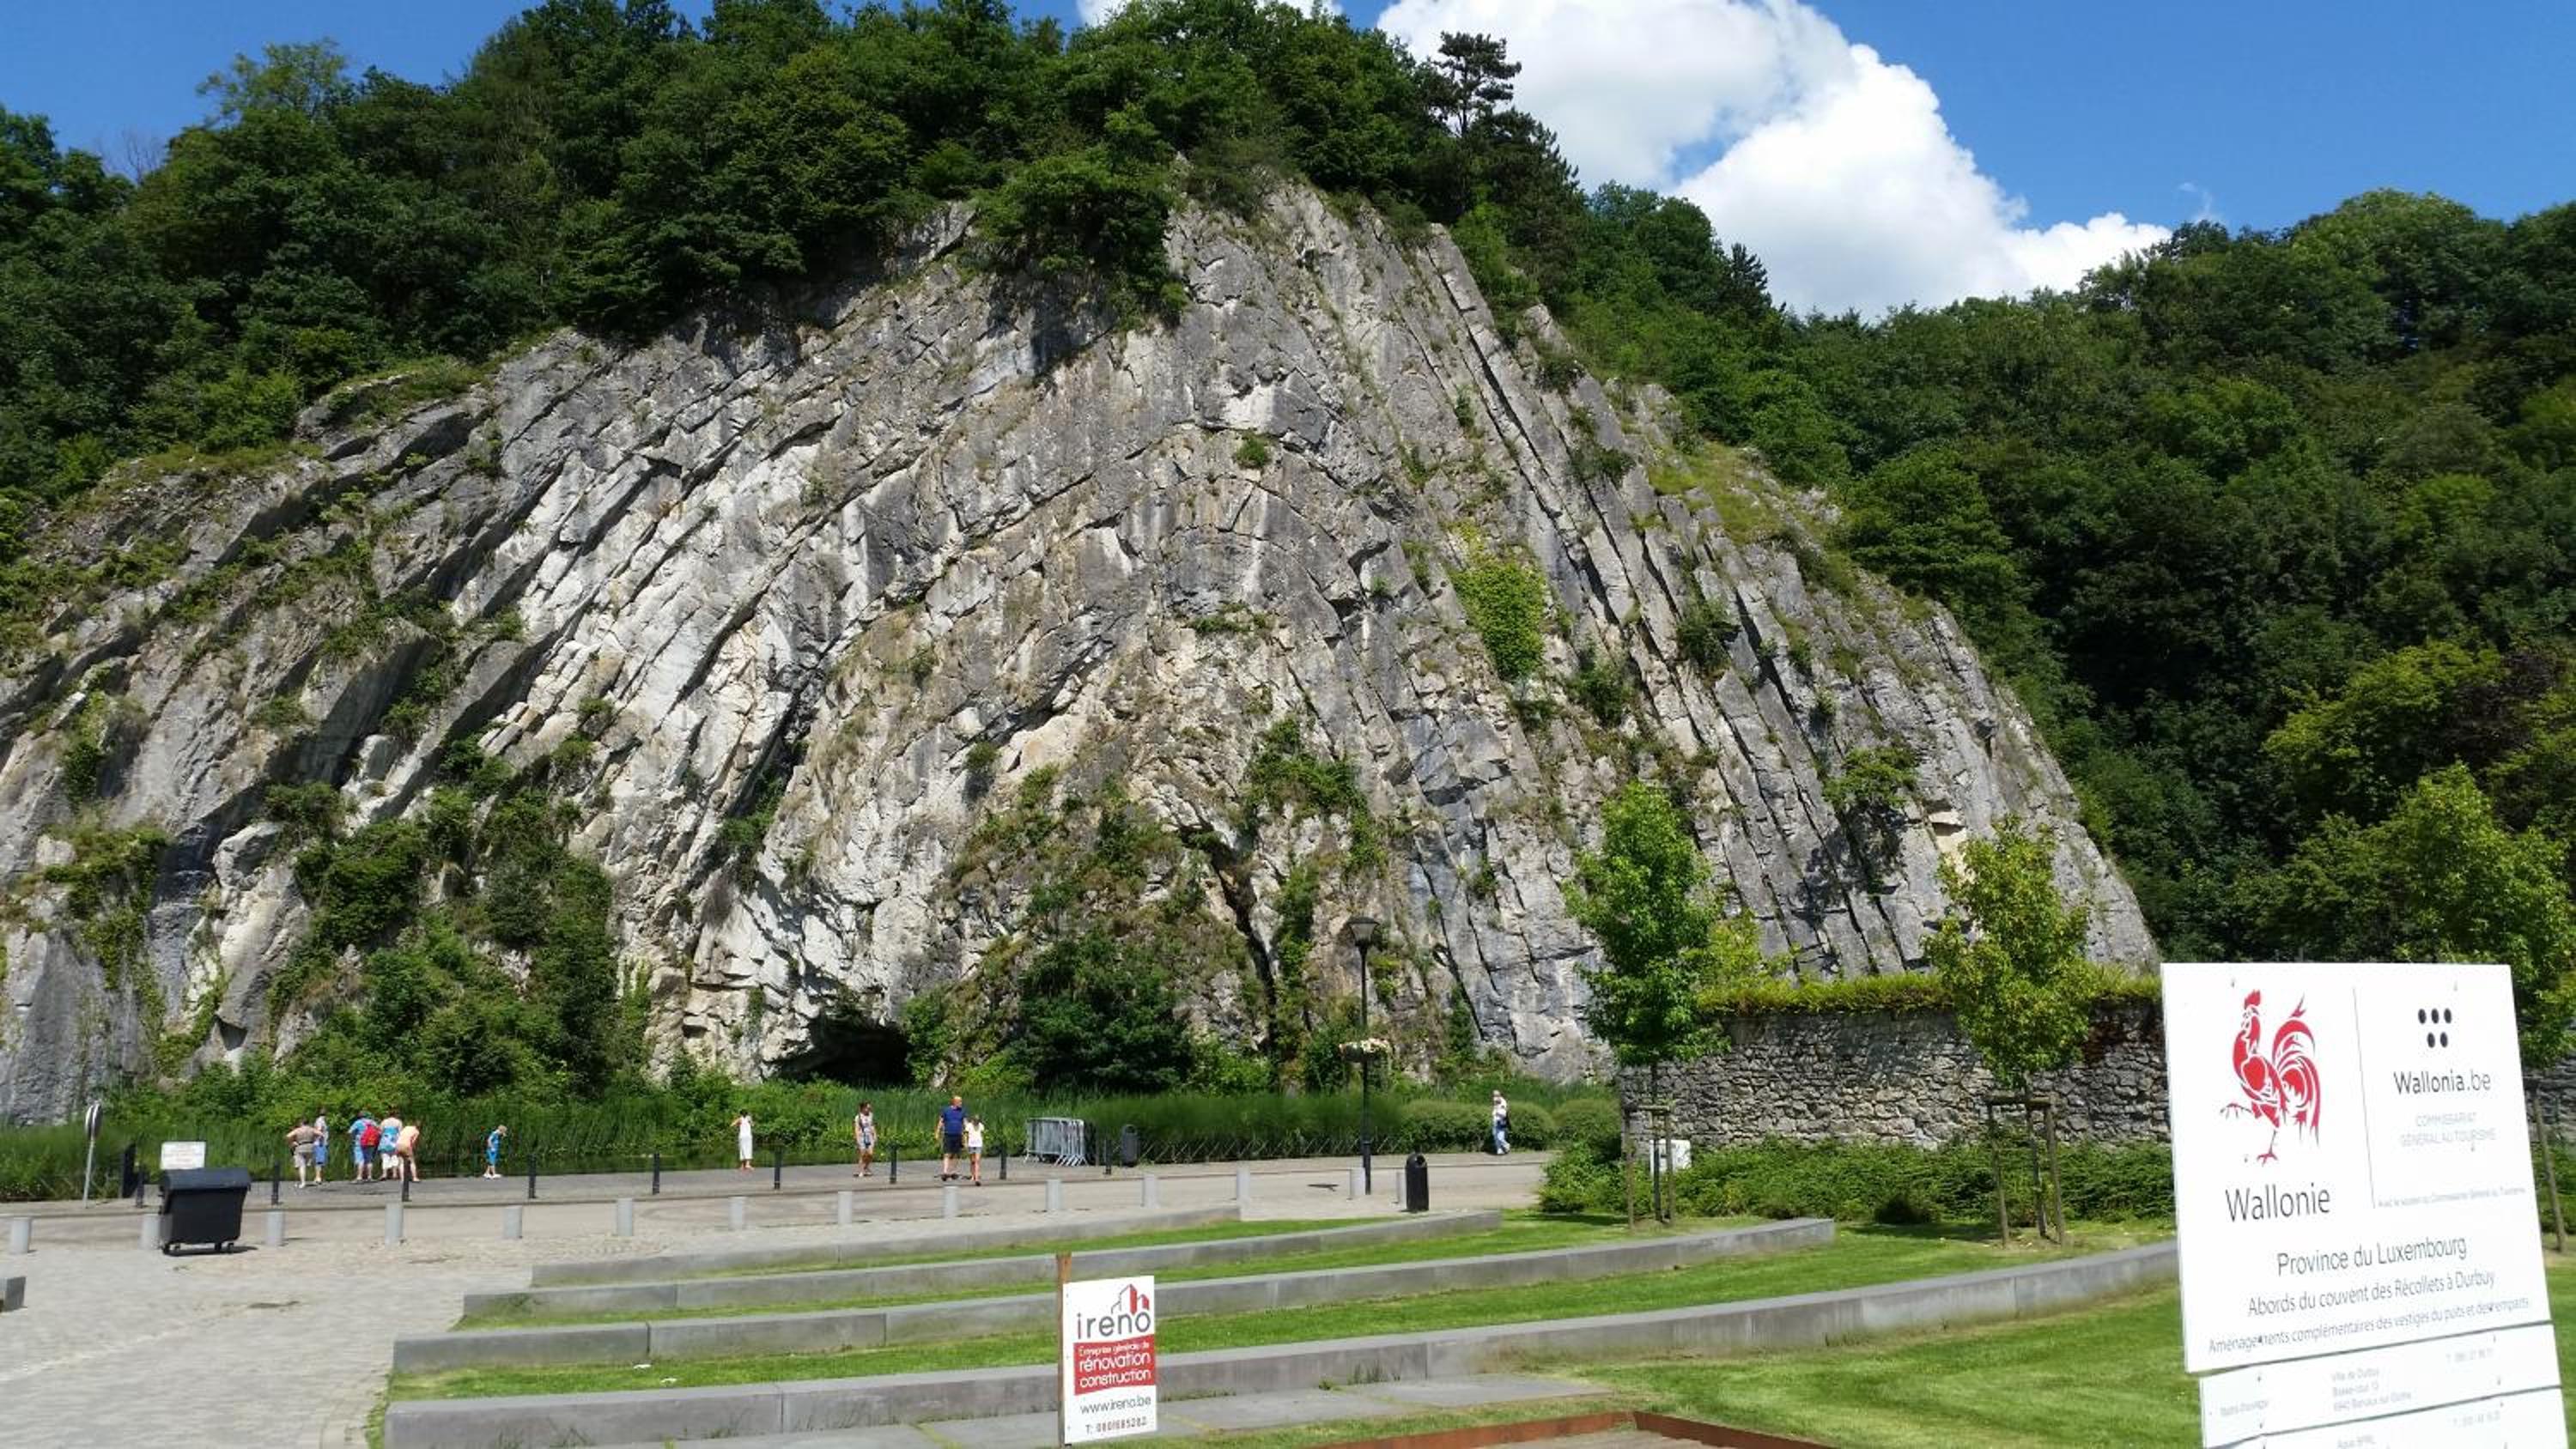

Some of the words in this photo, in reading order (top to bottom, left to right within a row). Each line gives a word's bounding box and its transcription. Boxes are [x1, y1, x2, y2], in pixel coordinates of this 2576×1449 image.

[2393, 1068, 2491, 1095] Wallonia.be
[2226, 1182, 2331, 1223] Wallonie
[2276, 1249, 2348, 1276] Province
[2354, 1244, 2372, 1266] du
[2376, 1237, 2468, 1265] Luxembourg
[2248, 1293, 2296, 1316] Abords
[2299, 1291, 2316, 1310] du
[2318, 1286, 2370, 1307] couvent
[2371, 1282, 2392, 1300] des
[2395, 1275, 2445, 1298] Récollets
[2446, 1273, 2454, 1290] à
[2455, 1270, 2495, 1290] Durbuy
[1076, 1312, 1151, 1340] ireno
[2292, 1319, 2374, 1343] complémentaires
[2375, 1316, 2393, 1331] des
[2431, 1308, 2443, 1323] du
[1078, 1351, 1151, 1373] rénovation
[1079, 1368, 1151, 1388] construction
[1079, 1395, 1151, 1415] www.ireno.be
